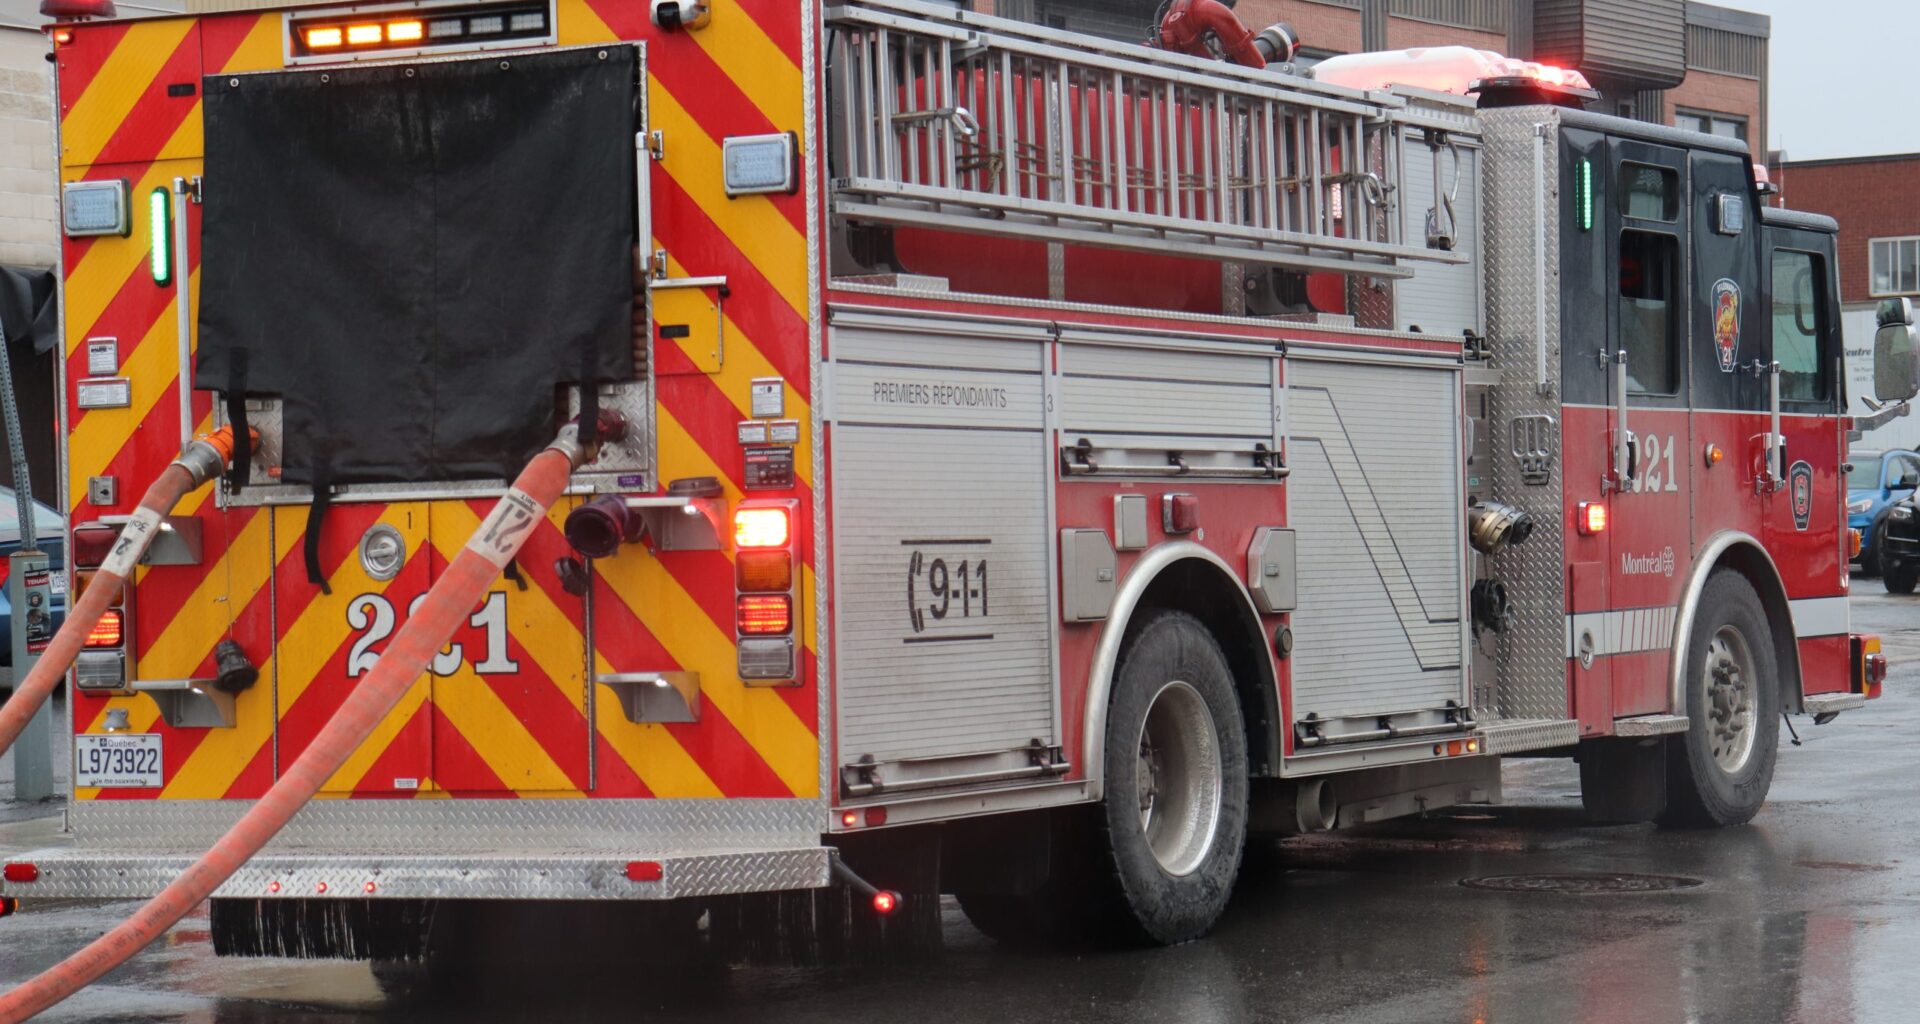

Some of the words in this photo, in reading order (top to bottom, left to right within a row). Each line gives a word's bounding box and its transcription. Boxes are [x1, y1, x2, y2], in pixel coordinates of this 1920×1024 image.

[873, 381, 929, 405] PREMIERS
[933, 381, 1007, 408] RÉPONDANTS
[1047, 394, 1054, 413] 3
[1275, 405, 1281, 422] 2
[407, 511, 412, 530] 1
[1622, 552, 1663, 575] Montréal
[929, 557, 988, 620] 9-1-1
[78, 748, 158, 774] L973922
